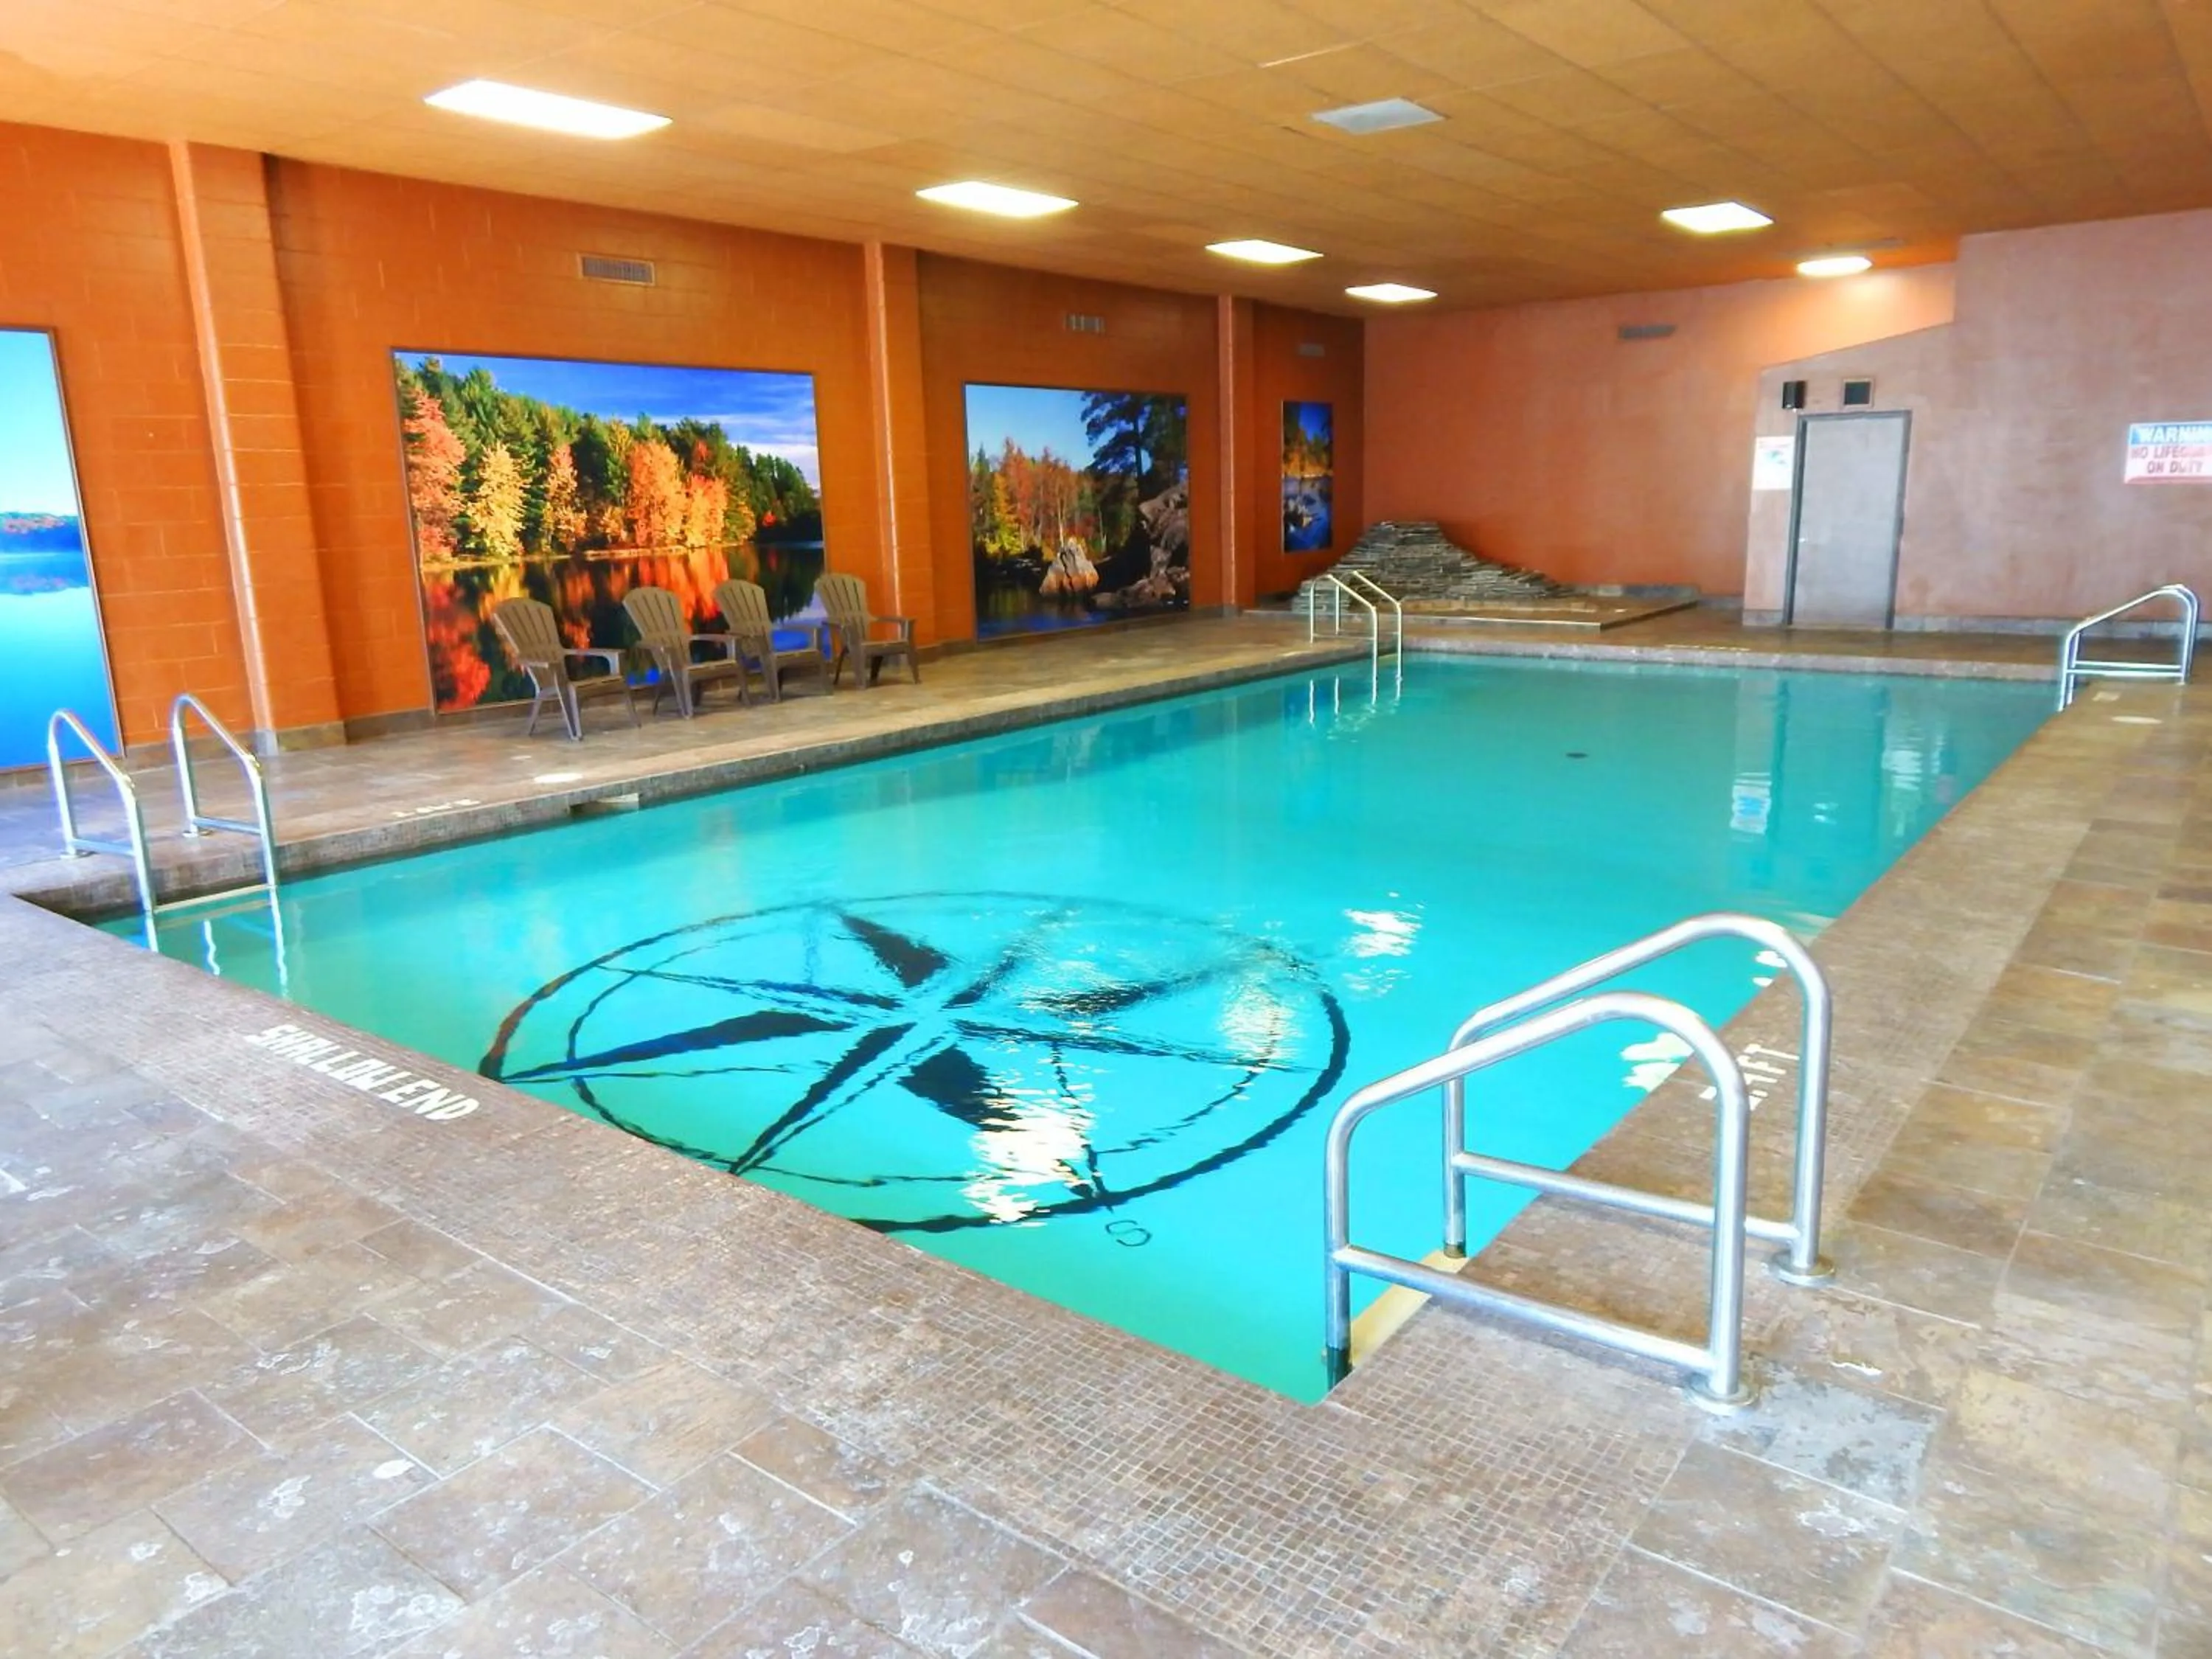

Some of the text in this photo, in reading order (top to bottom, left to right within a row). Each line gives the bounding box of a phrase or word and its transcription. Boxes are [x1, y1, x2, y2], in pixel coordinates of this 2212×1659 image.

[2146, 460, 2203, 473] ON DUTY
[377, 1078, 480, 1121] END
